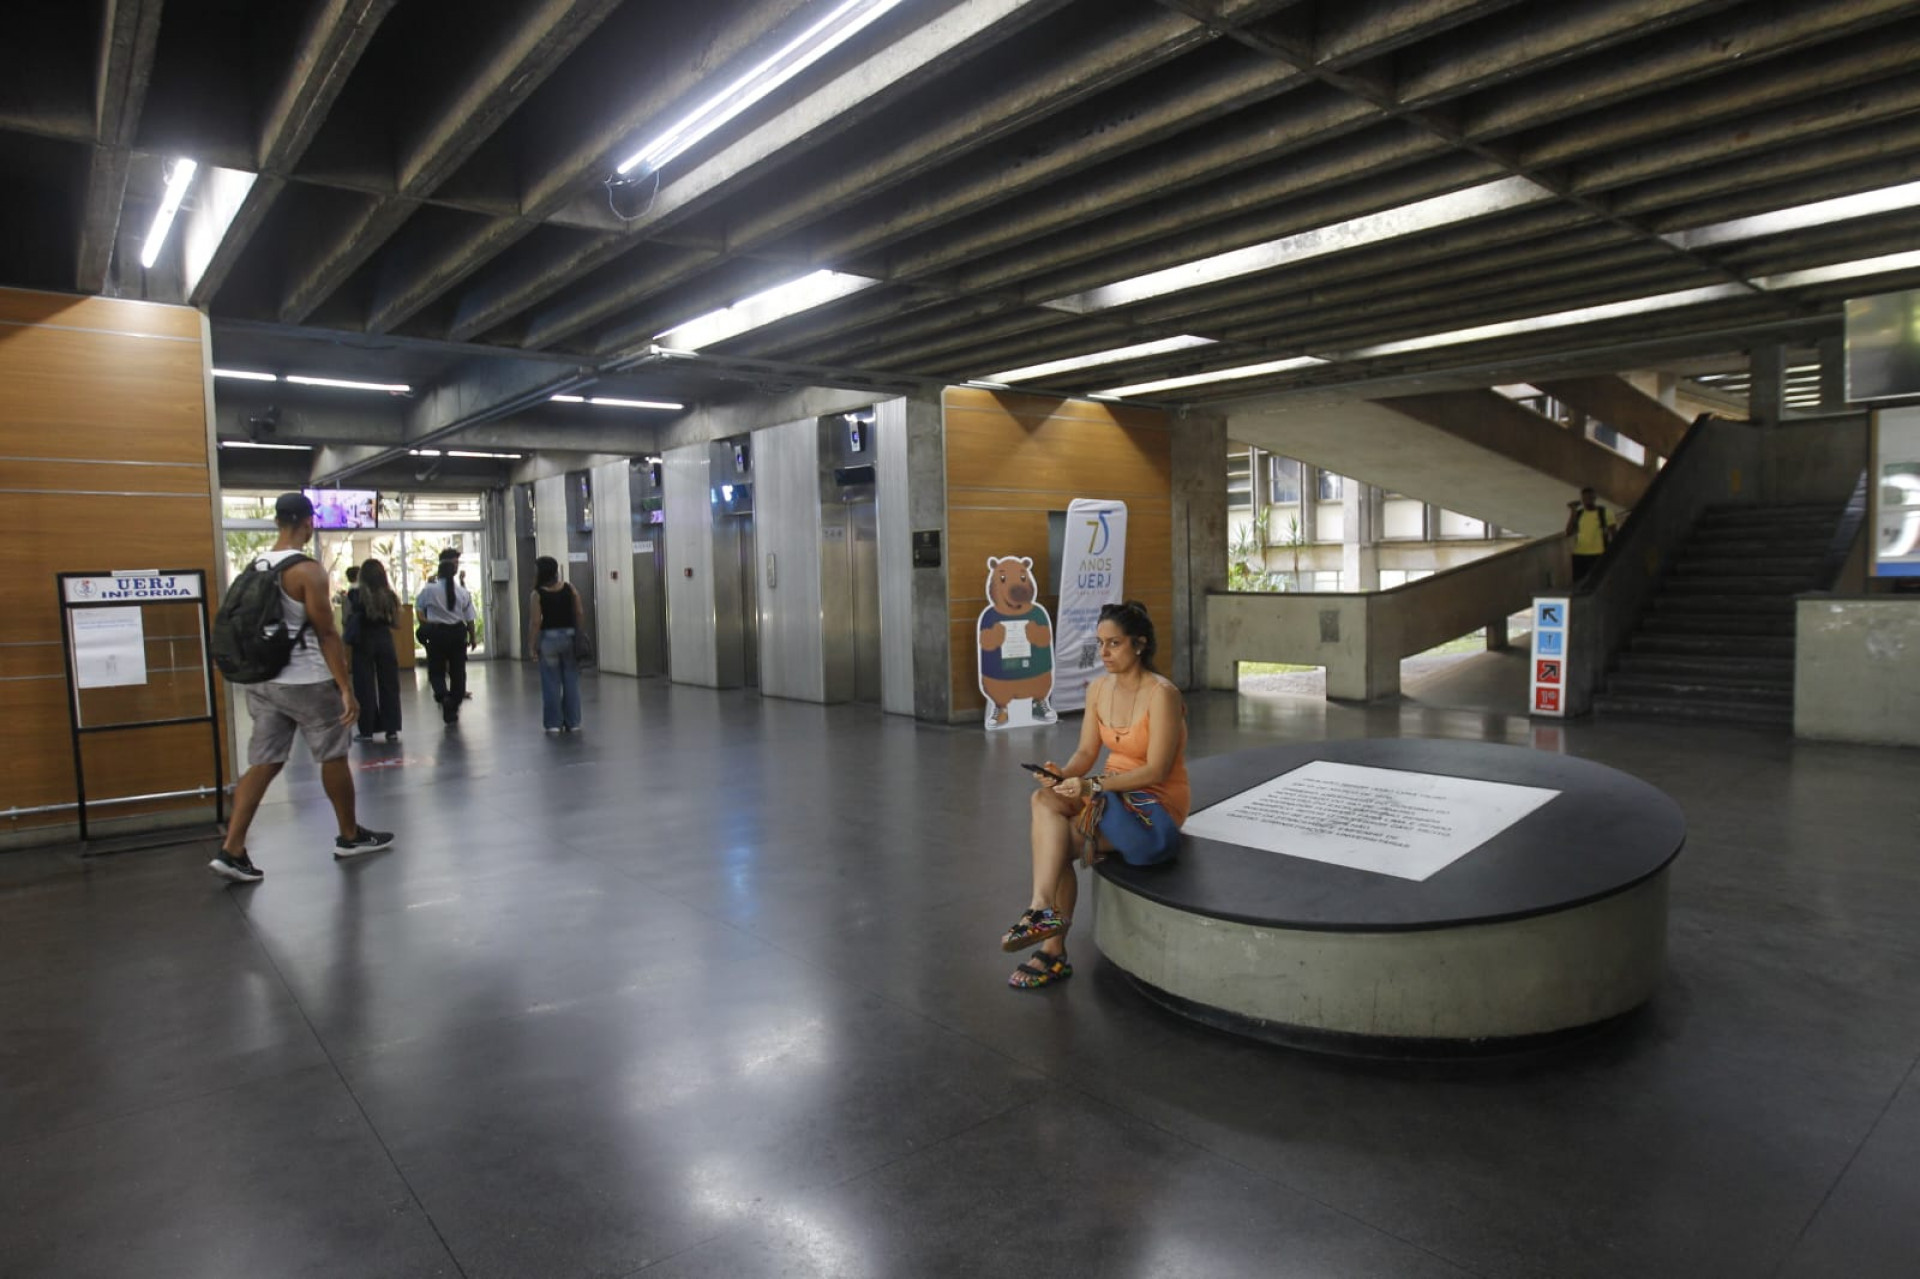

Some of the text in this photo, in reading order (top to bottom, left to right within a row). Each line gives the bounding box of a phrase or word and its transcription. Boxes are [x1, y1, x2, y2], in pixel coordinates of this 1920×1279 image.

[1086, 510, 1113, 555] 75
[1079, 558, 1113, 572] ANOS
[117, 577, 176, 589] UERJ
[1078, 574, 1111, 589] UERJ
[102, 588, 191, 598] INFORMA
